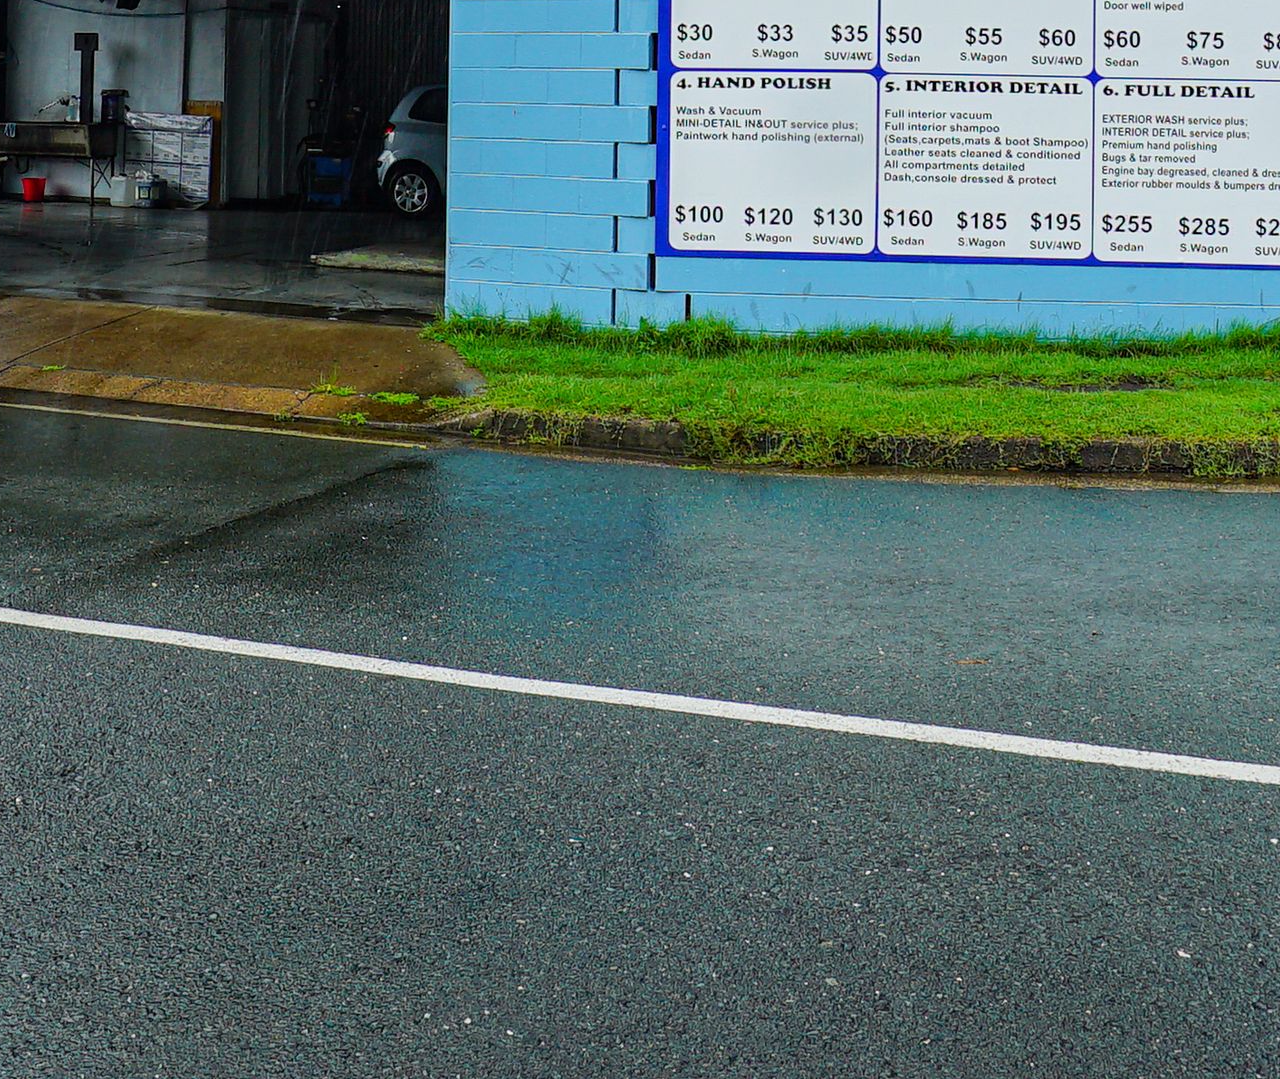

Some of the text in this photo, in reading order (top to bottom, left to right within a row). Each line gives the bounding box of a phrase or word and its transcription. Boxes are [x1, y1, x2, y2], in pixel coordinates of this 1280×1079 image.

[1104, 0, 1184, 13] Door well wiped
[677, 23, 868, 43] $30 $33 $35
[886, 25, 1075, 48] $50 $55 $60
[1104, 30, 1140, 49] $60
[1187, 31, 1224, 50] $75
[678, 50, 711, 60] Sedan
[752, 48, 799, 60] S.Wagon
[887, 52, 1083, 65] Sedan S.Wagon SUV/4WD
[1105, 57, 1139, 67] Sedan
[1181, 56, 1229, 68] S.Wagon
[677, 77, 831, 89] 4. HAND POLISH
[885, 80, 1083, 95] 5. INTERIOR DETAIL
[1103, 85, 1255, 98] 6. FULL DETAIL
[885, 109, 992, 120] Full interior vacuum
[1102, 114, 1152, 124] EXTERIOR
[1155, 115, 1185, 125] WASH
[1188, 116, 1222, 125] service
[676, 118, 741, 128] MINI-DETAIL
[745, 119, 787, 129] IN&OUT
[790, 120, 829, 130] service
[676, 131, 864, 144] Paintwork hand polishing (external)
[1102, 140, 1217, 153] Premium hand polishing
[884, 147, 1081, 160] Leather seats cleaned & conditioned
[1102, 152, 1196, 164] Bugs & tar removed
[884, 160, 1025, 171] All compartments detailed
[675, 205, 862, 226] $100 $120 $130
[883, 208, 1081, 231] $160 $185 $195
[1102, 214, 1152, 233] $255
[1179, 217, 1229, 236] $285
[683, 232, 863, 246] Sedan S.Wagon SUV/4WD
[891, 236, 1081, 250] Sedan S.Wagon SUV/4WD
[1110, 242, 1144, 252] Sedan
[1180, 243, 1228, 255] S.Wagon
